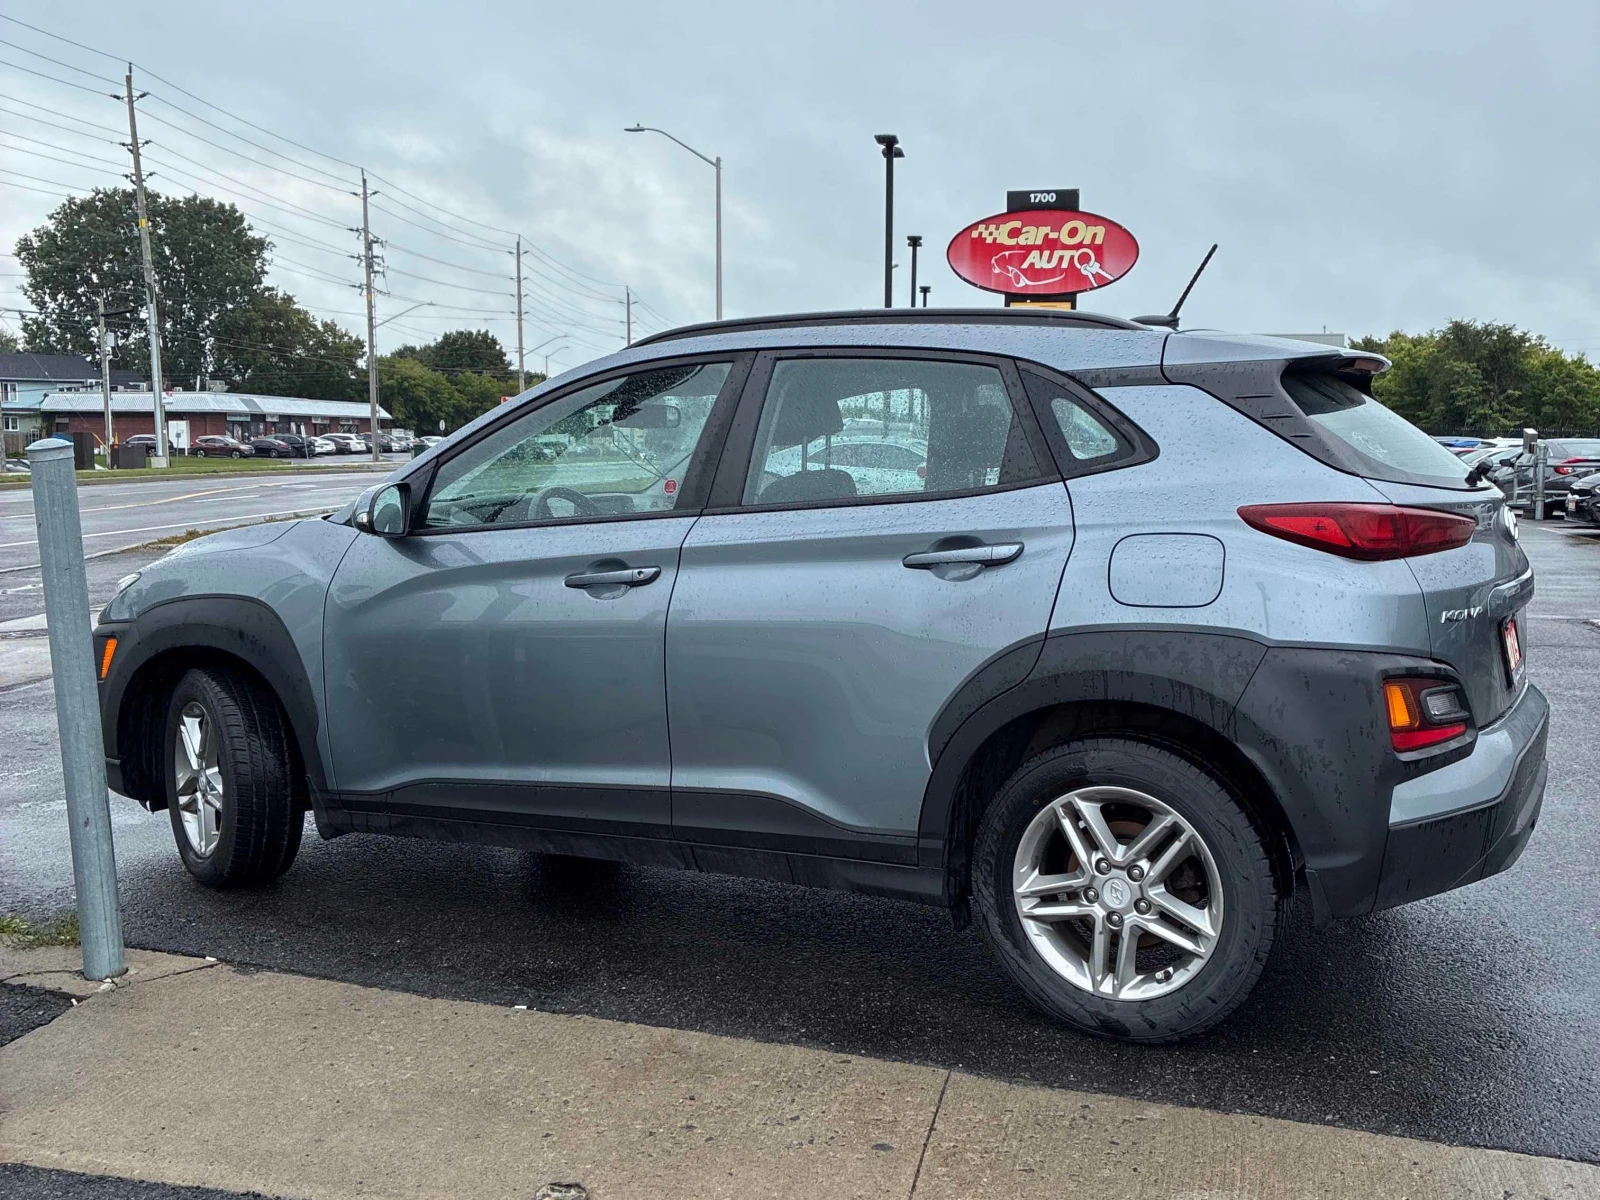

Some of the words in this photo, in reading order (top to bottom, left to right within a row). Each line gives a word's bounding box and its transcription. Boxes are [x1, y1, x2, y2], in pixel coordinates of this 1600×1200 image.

[1029, 192, 1056, 203] 1700
[1003, 220, 1106, 246] Car-On
[1020, 247, 1096, 271] AUTO
